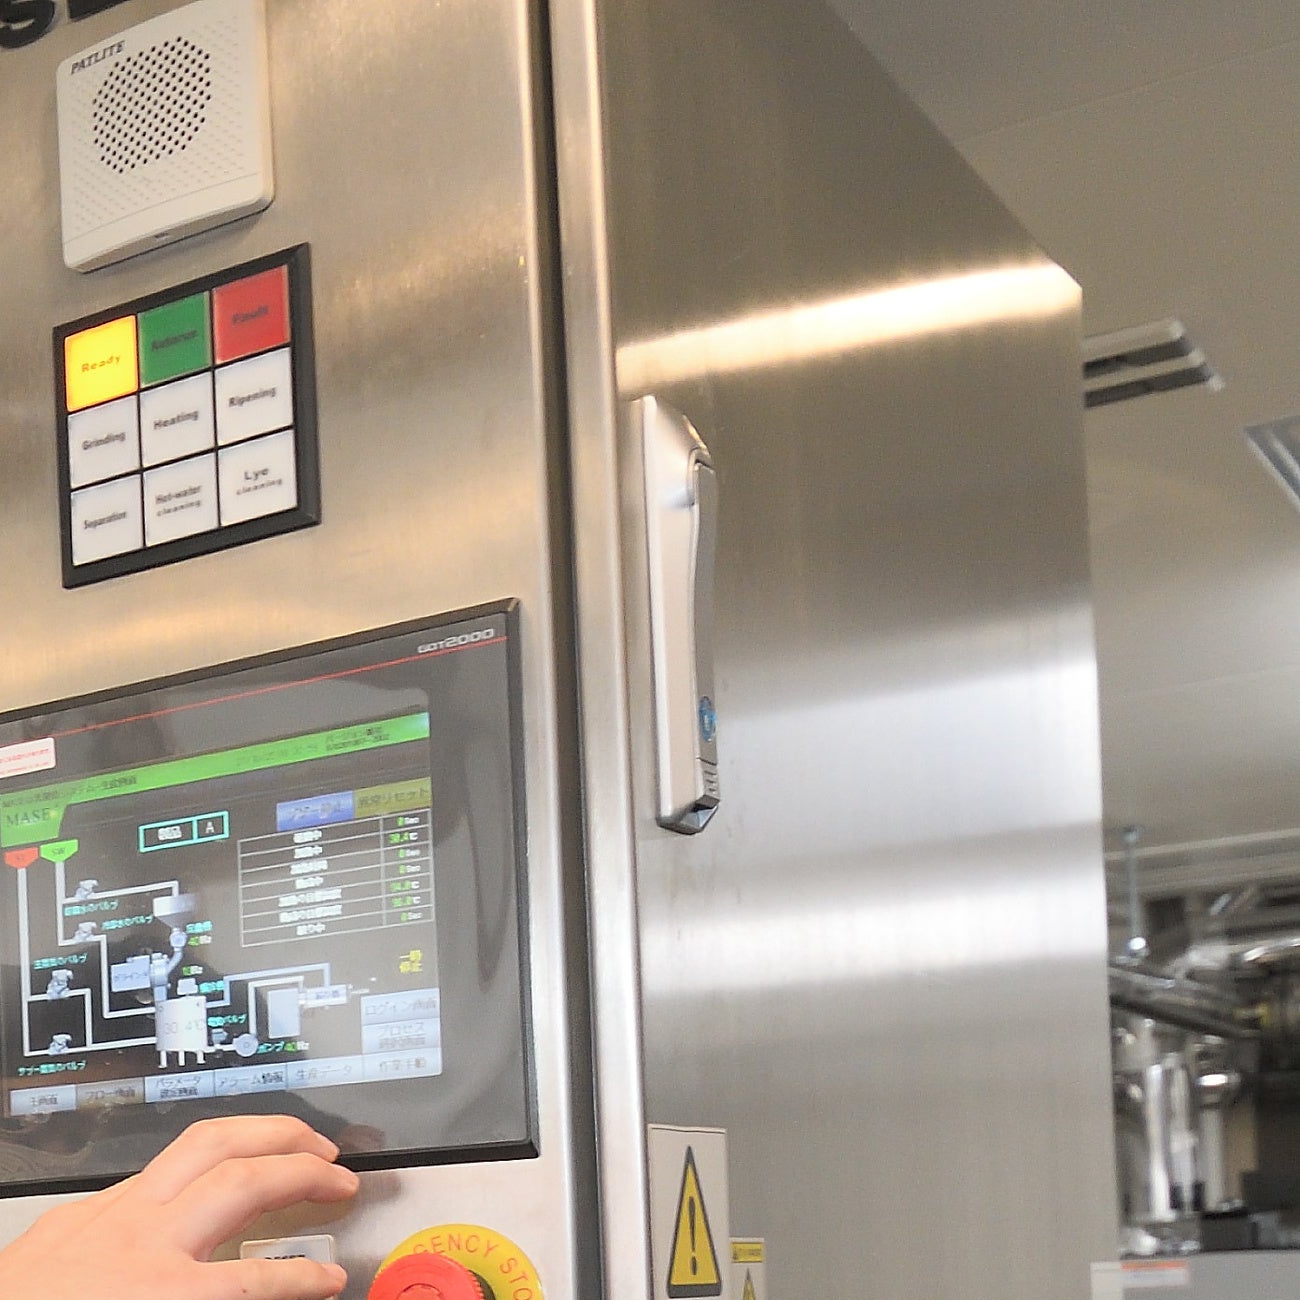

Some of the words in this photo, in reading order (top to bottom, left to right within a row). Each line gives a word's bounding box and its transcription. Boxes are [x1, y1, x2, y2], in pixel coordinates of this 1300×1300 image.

[70, 40, 126, 75] PATLITE
[81, 355, 121, 373] Ready
[228, 387, 276, 408] Ripening
[153, 409, 199, 430] Heating
[82, 431, 126, 450] Grinding
[236, 478, 283, 496] cleaning
[156, 500, 201, 517] cleaning
[417, 628, 495, 653] GOT2000
[413, 1233, 499, 1258] GENCY
